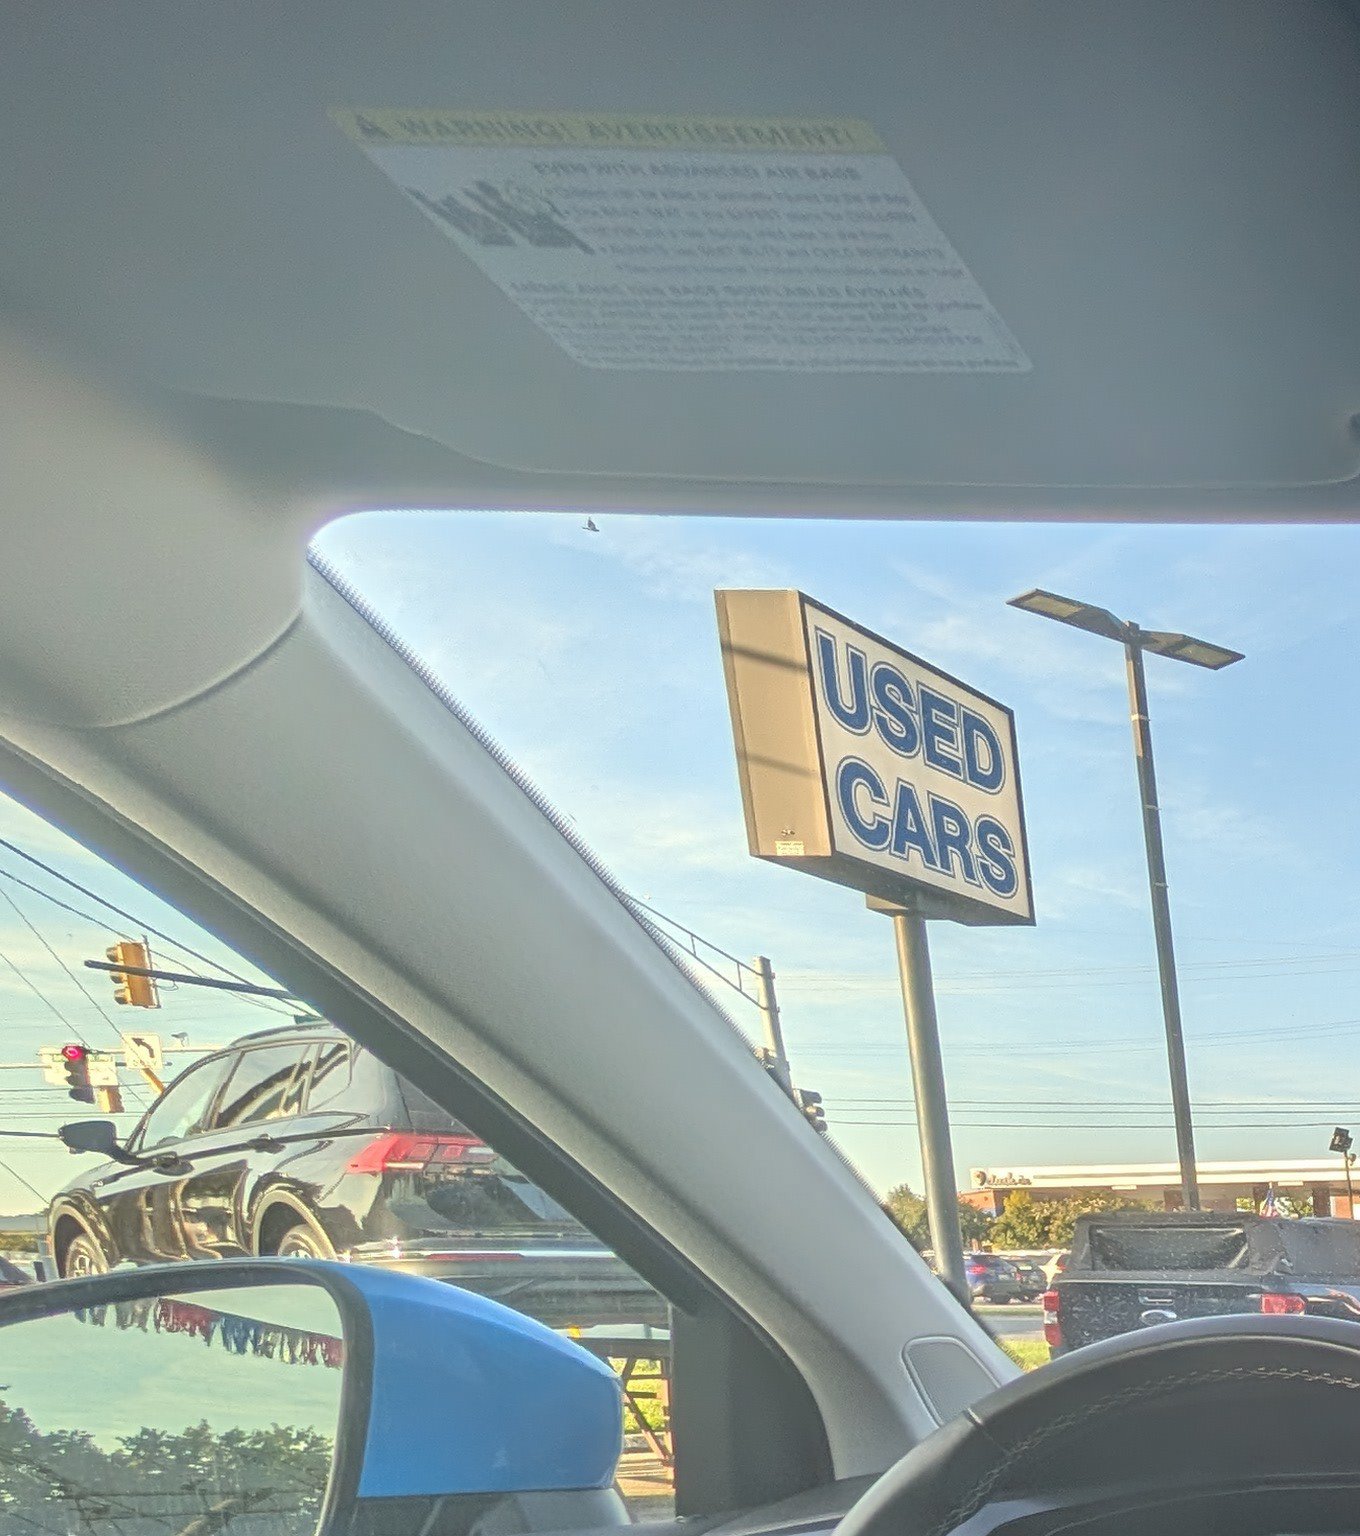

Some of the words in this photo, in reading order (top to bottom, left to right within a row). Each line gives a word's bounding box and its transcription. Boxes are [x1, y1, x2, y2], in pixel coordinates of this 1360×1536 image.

[403, 118, 569, 142] WARNING!
[586, 121, 857, 146] AVERTISSEMENT!
[814, 626, 1006, 795] USED
[834, 755, 1019, 898] CARS
